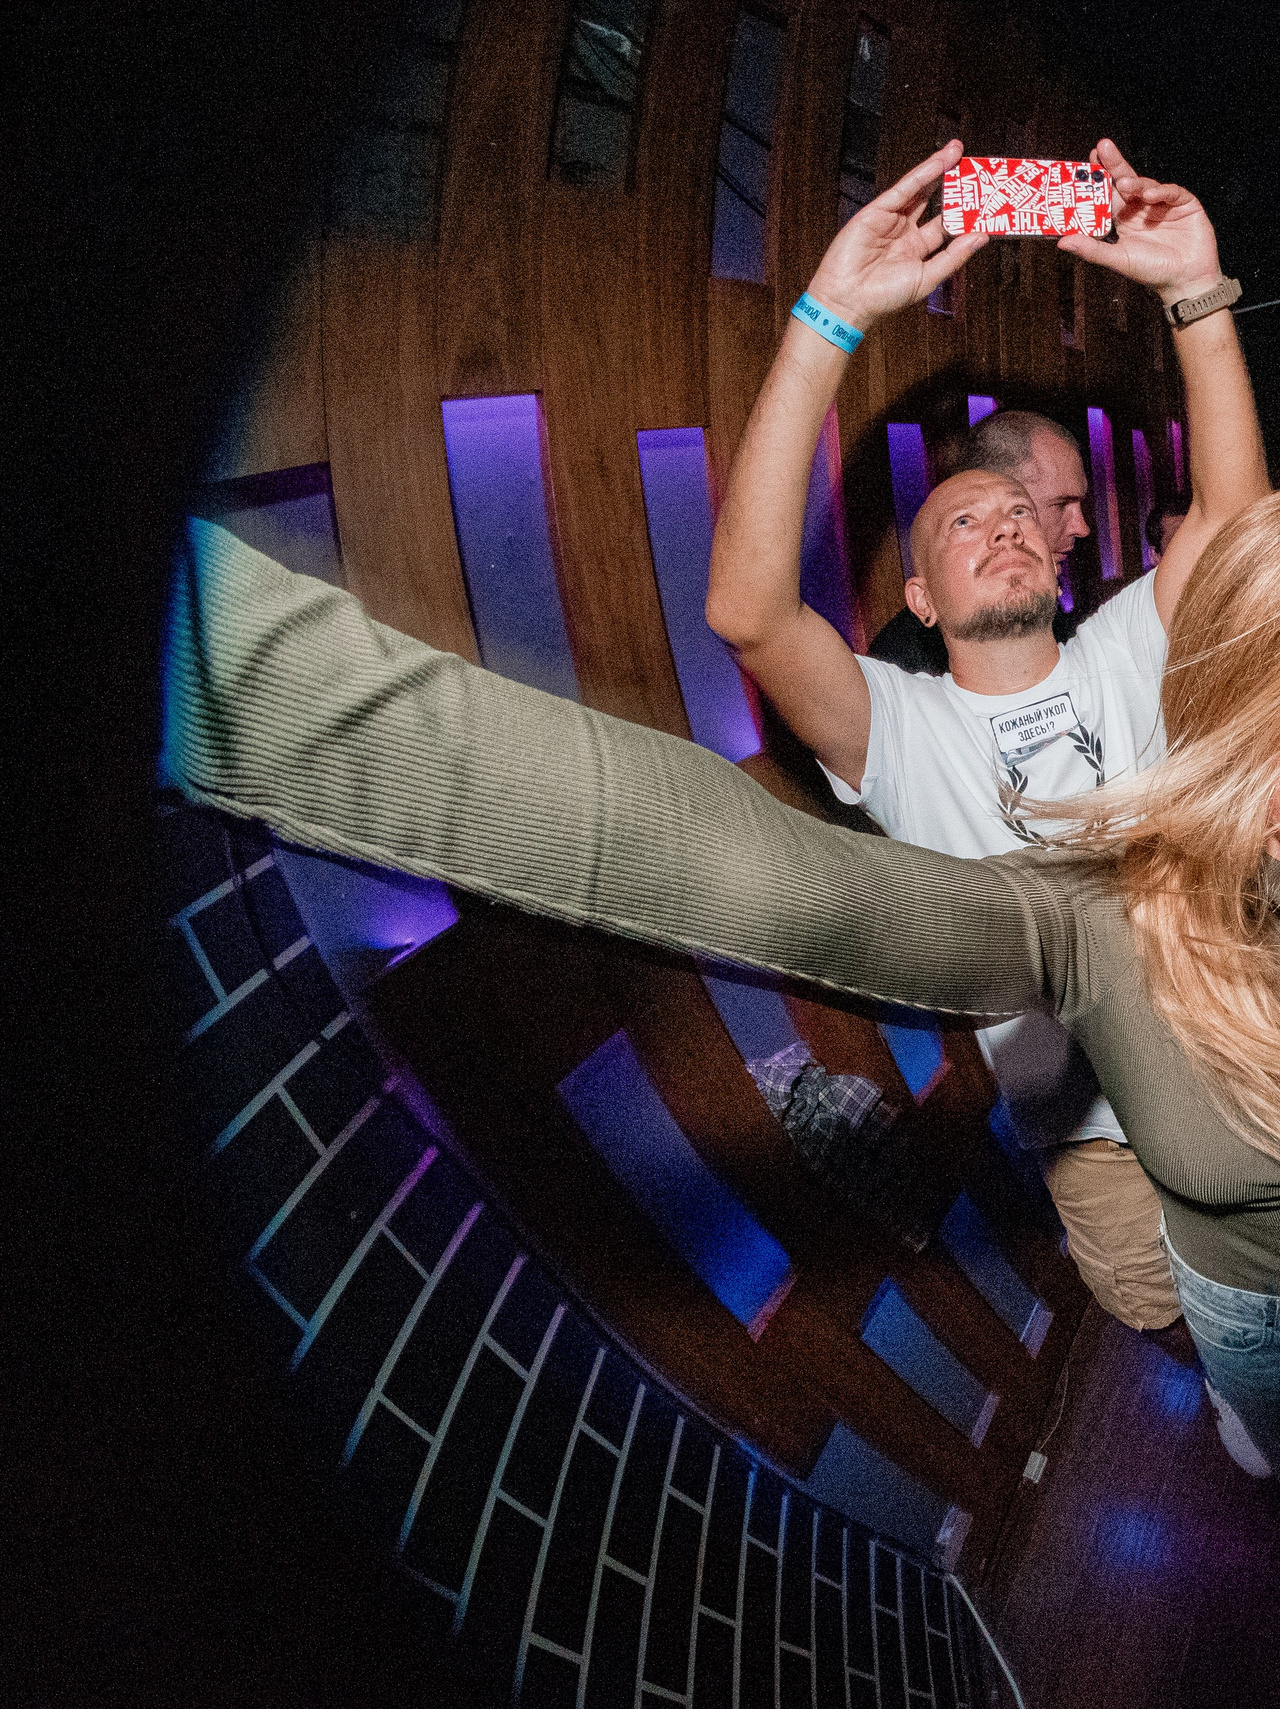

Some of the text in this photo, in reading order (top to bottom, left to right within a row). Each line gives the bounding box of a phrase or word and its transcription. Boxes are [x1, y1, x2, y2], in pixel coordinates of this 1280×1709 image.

[943, 179, 962, 207] THE
[961, 173, 979, 212] VANS
[1001, 177, 1027, 198] THE
[1008, 184, 1038, 210] VANS
[1048, 184, 1063, 205] THE
[1062, 181, 1075, 208] VANS
[1011, 211, 1041, 231] THE
[998, 702, 1067, 734] КОЖАНЫЙ УКОЛ
[1018, 721, 1055, 742] ЗДЕСЬ!?
